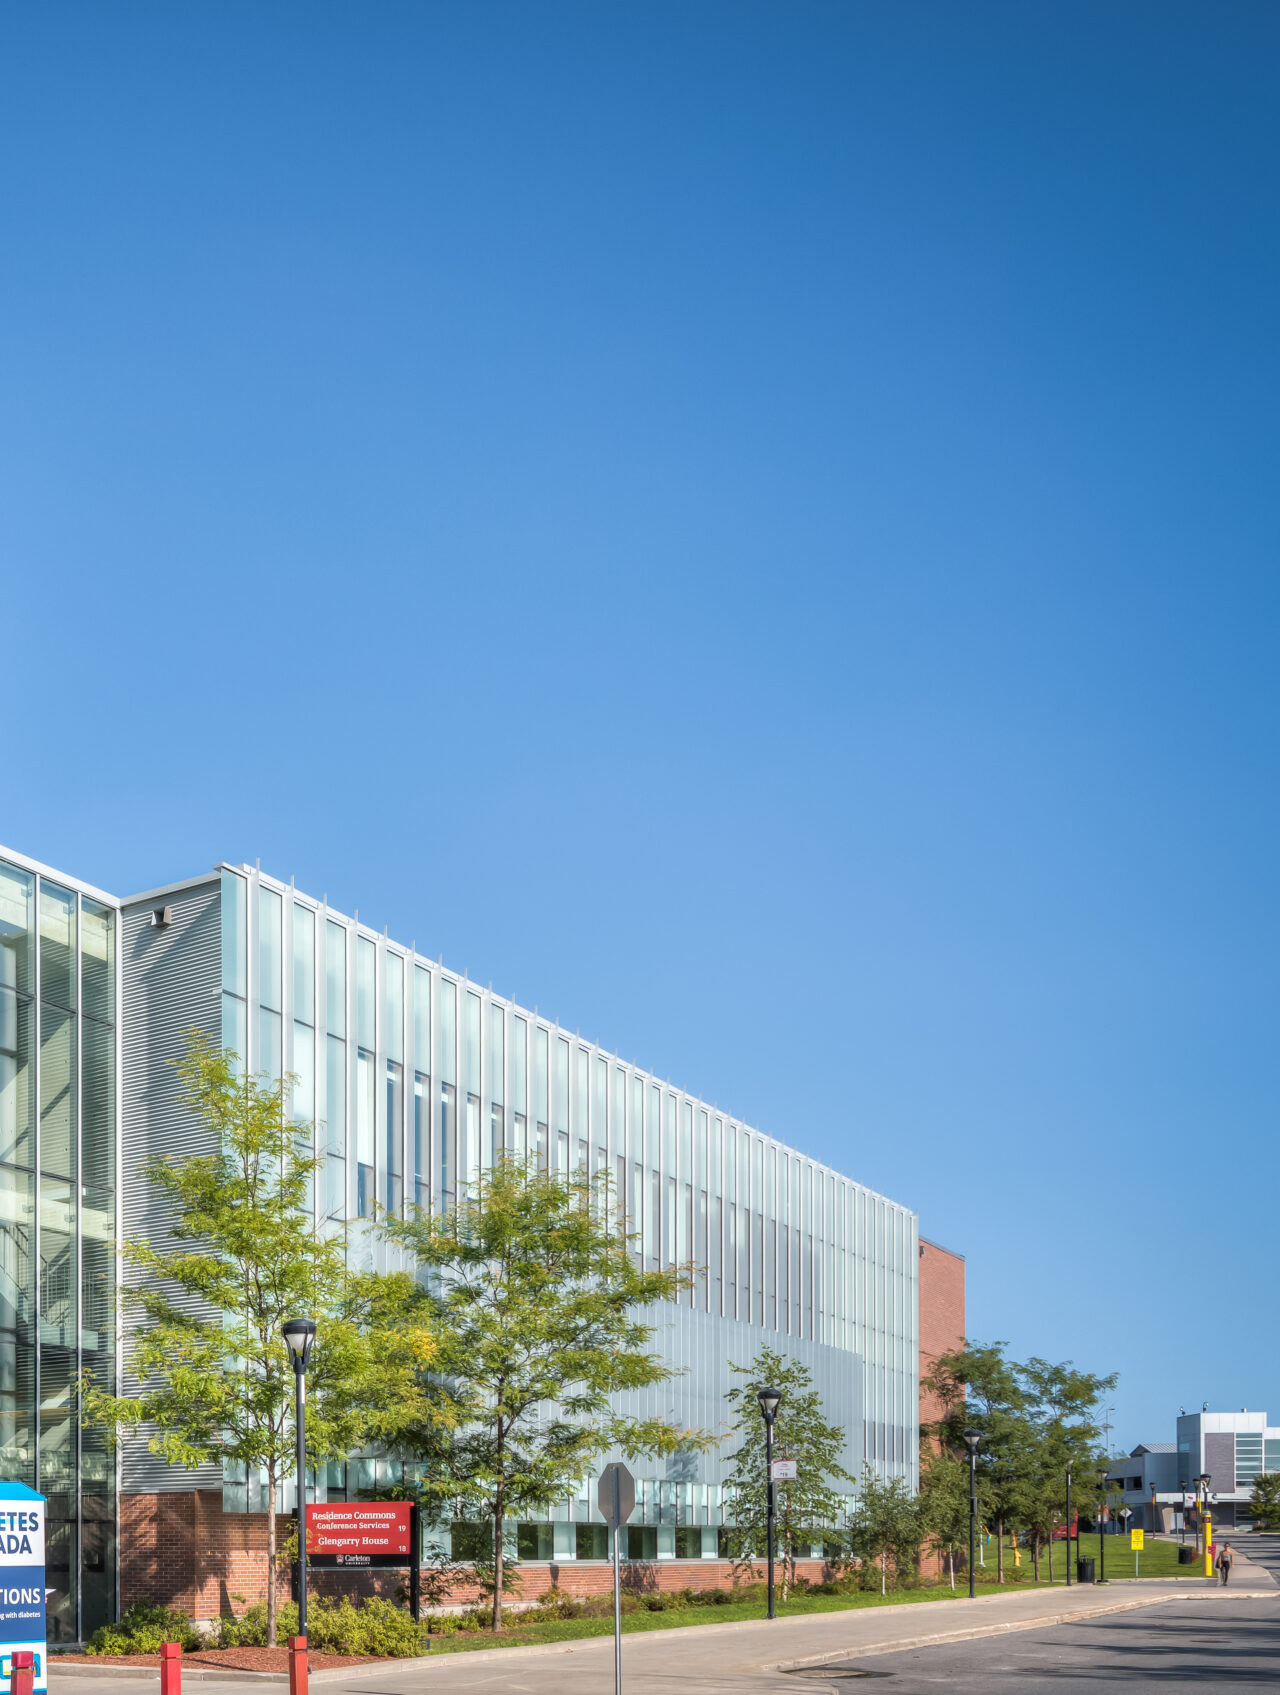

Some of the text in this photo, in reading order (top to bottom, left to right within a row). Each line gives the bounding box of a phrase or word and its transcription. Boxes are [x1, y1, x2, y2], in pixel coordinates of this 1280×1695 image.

[312, 1511, 396, 1520] Residence Commons
[317, 1521, 390, 1530] Conference Services
[318, 1536, 389, 1547] Glengarry House
[344, 1554, 371, 1562] Carleton
[5, 1611, 17, 1619] with
